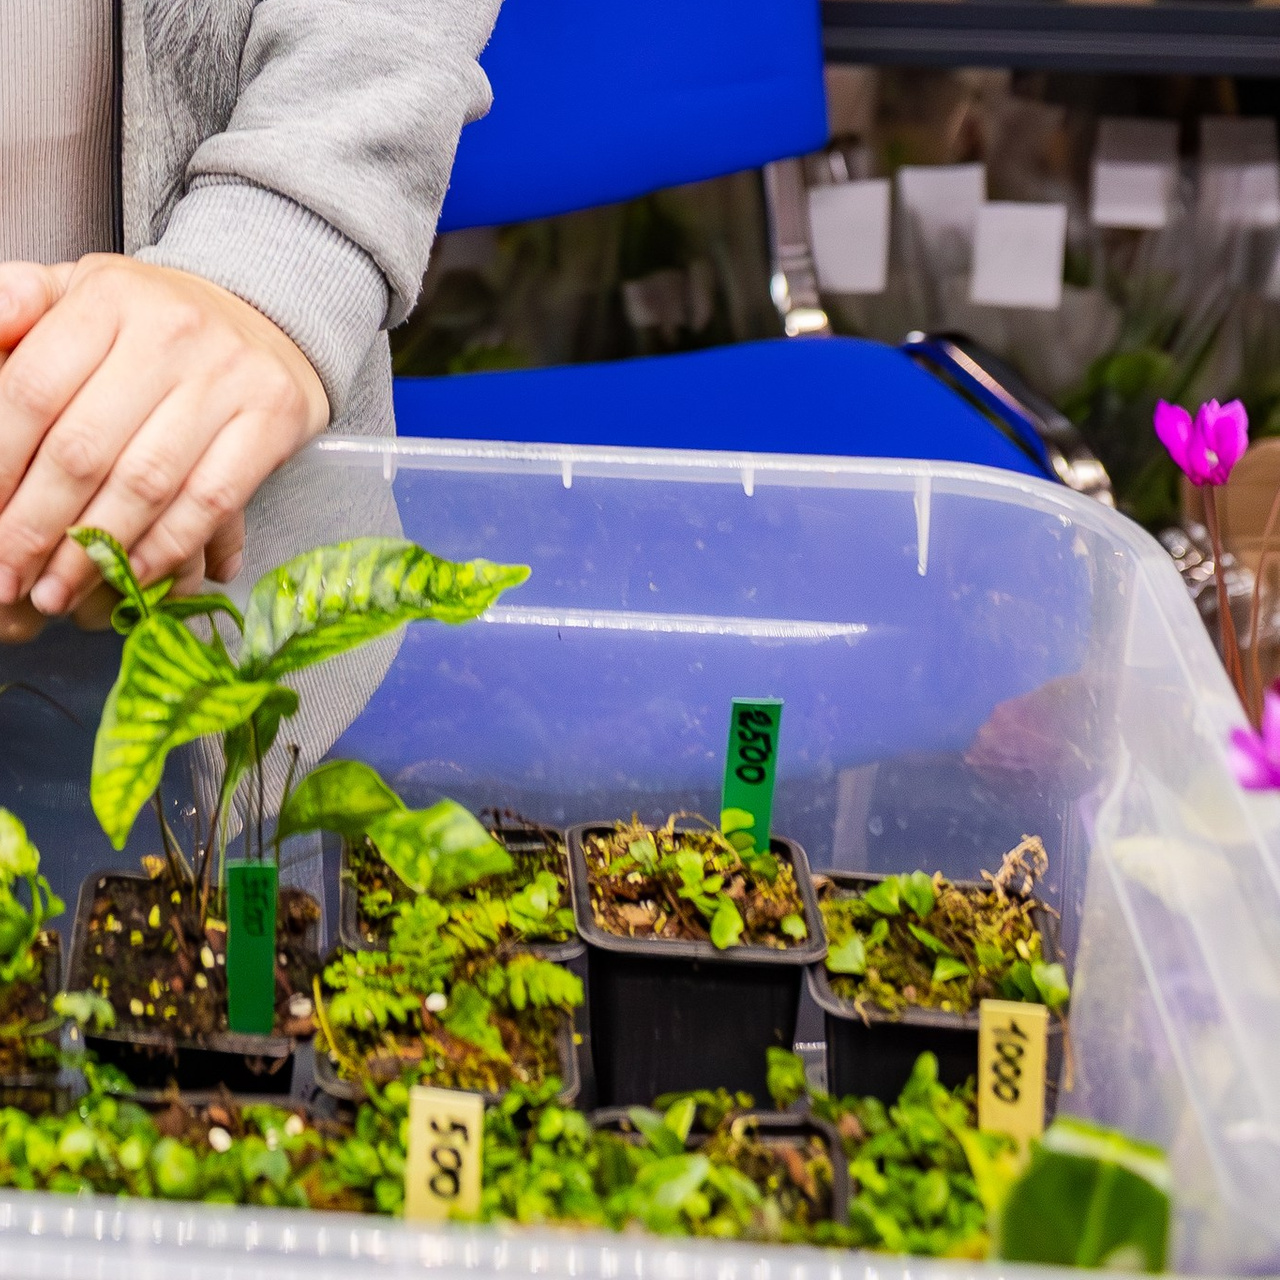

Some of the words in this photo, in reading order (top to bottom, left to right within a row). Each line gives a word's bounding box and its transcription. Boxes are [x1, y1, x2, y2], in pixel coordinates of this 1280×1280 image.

[735, 709, 773, 785] 2500
[992, 1017, 1029, 1104] 1000
[428, 1119, 469, 1200] 500
